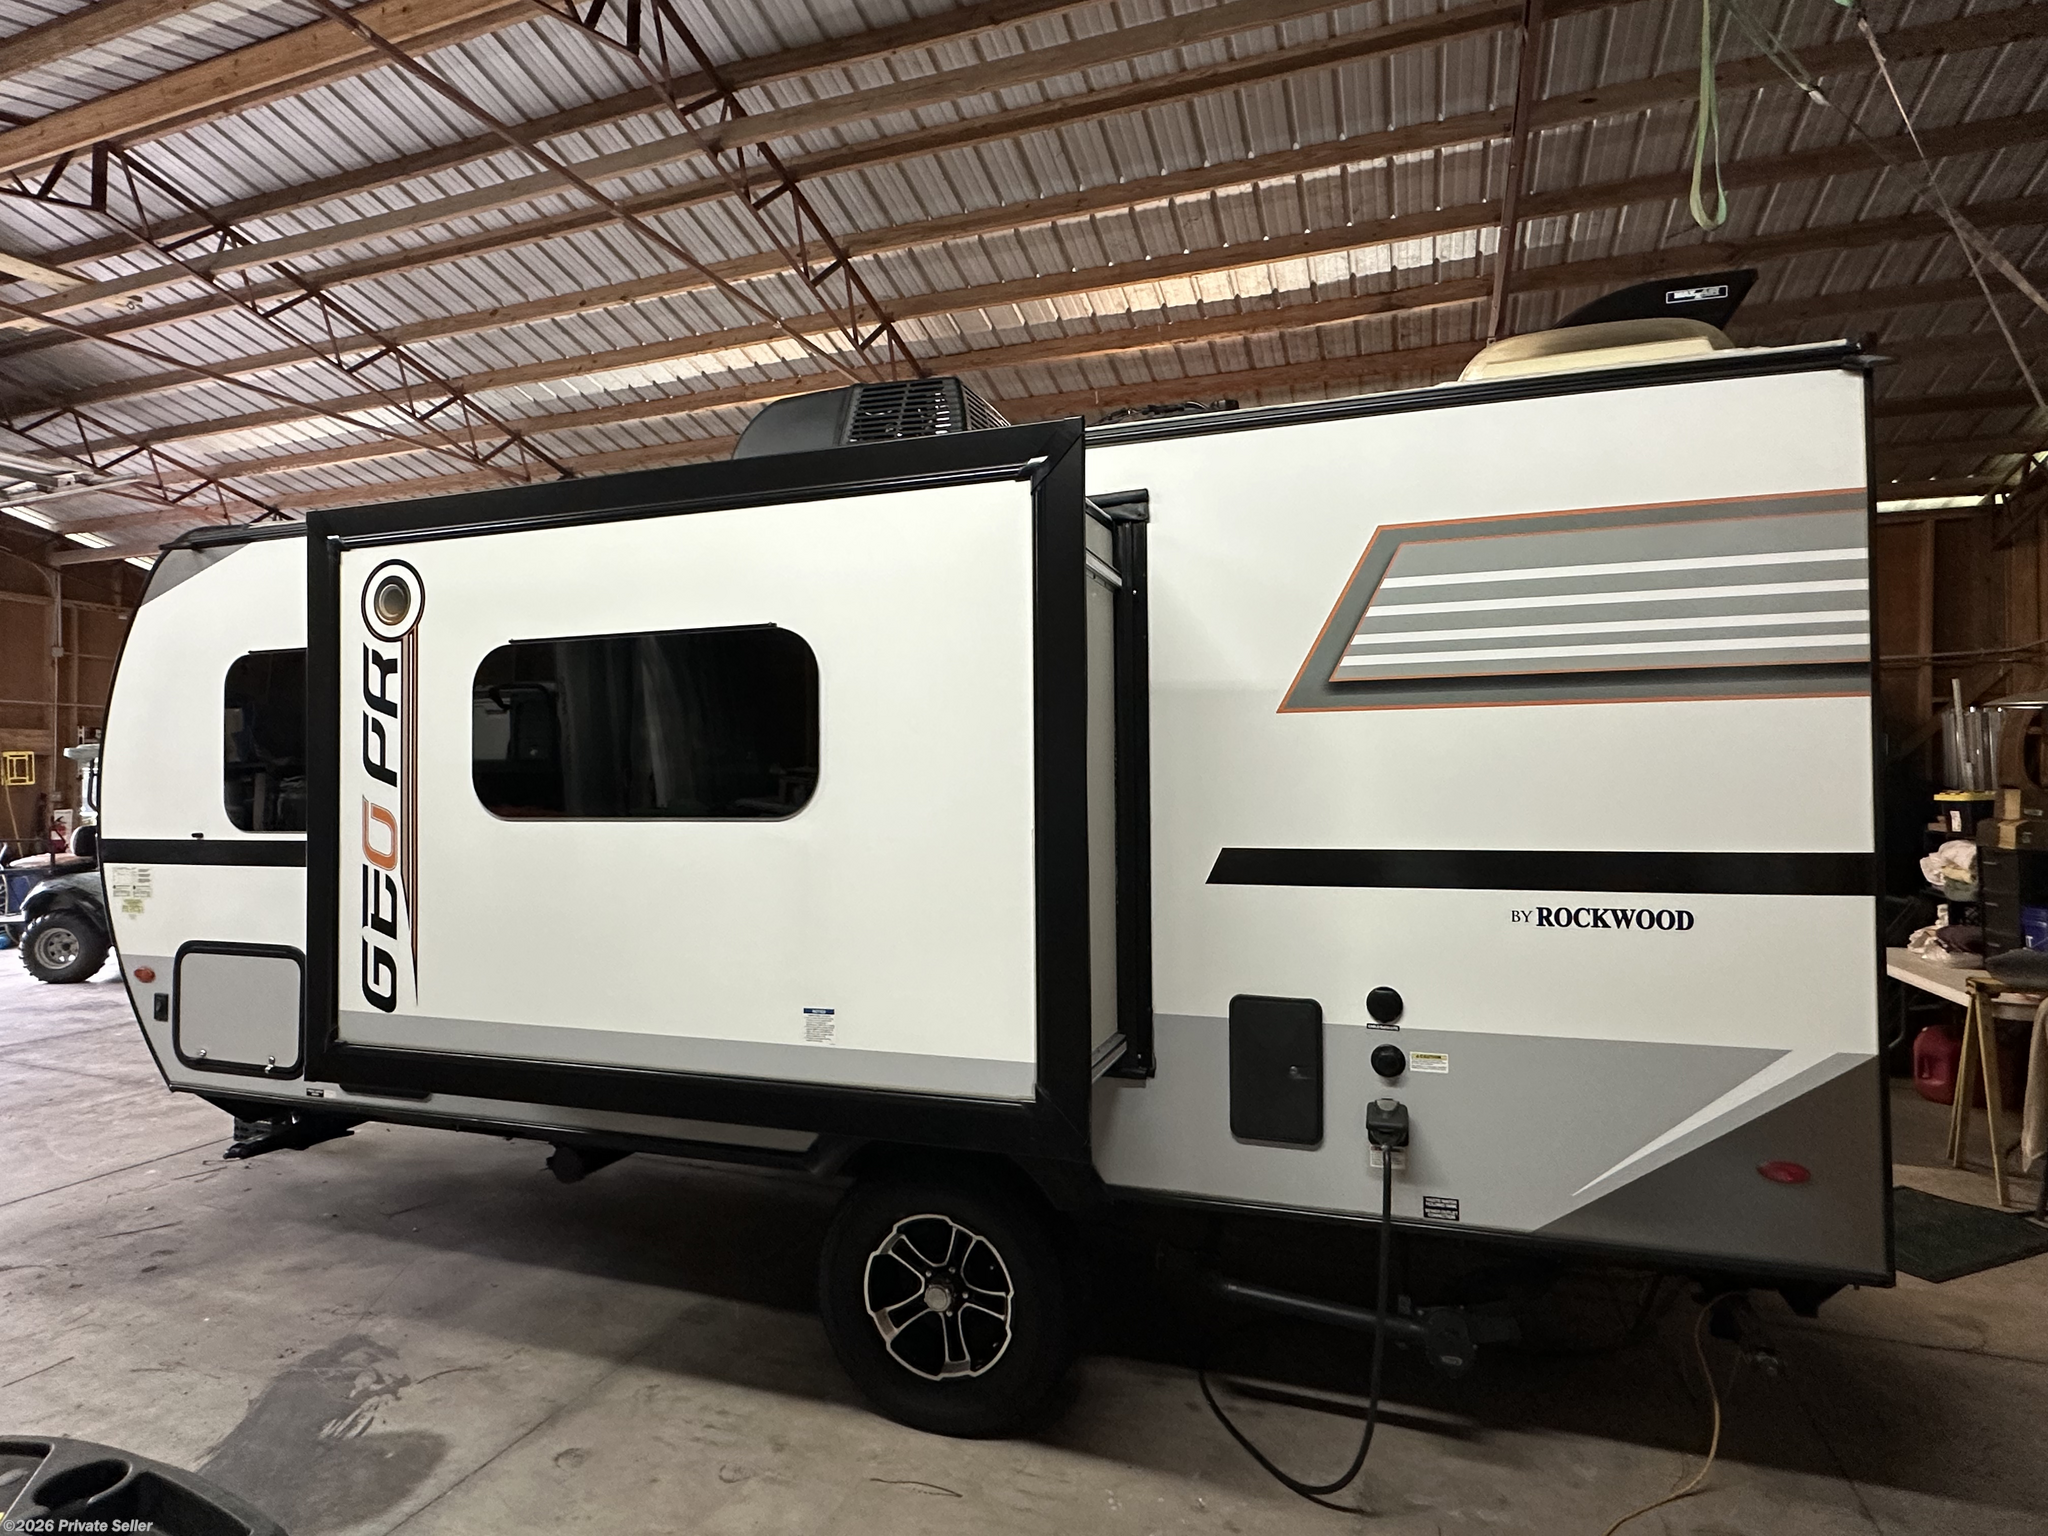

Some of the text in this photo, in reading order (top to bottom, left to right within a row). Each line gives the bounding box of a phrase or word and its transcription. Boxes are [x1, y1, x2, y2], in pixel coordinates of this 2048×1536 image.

[361, 558, 426, 1013] GEO PRO
[1511, 907, 1694, 931] BY ROCKWOOD
